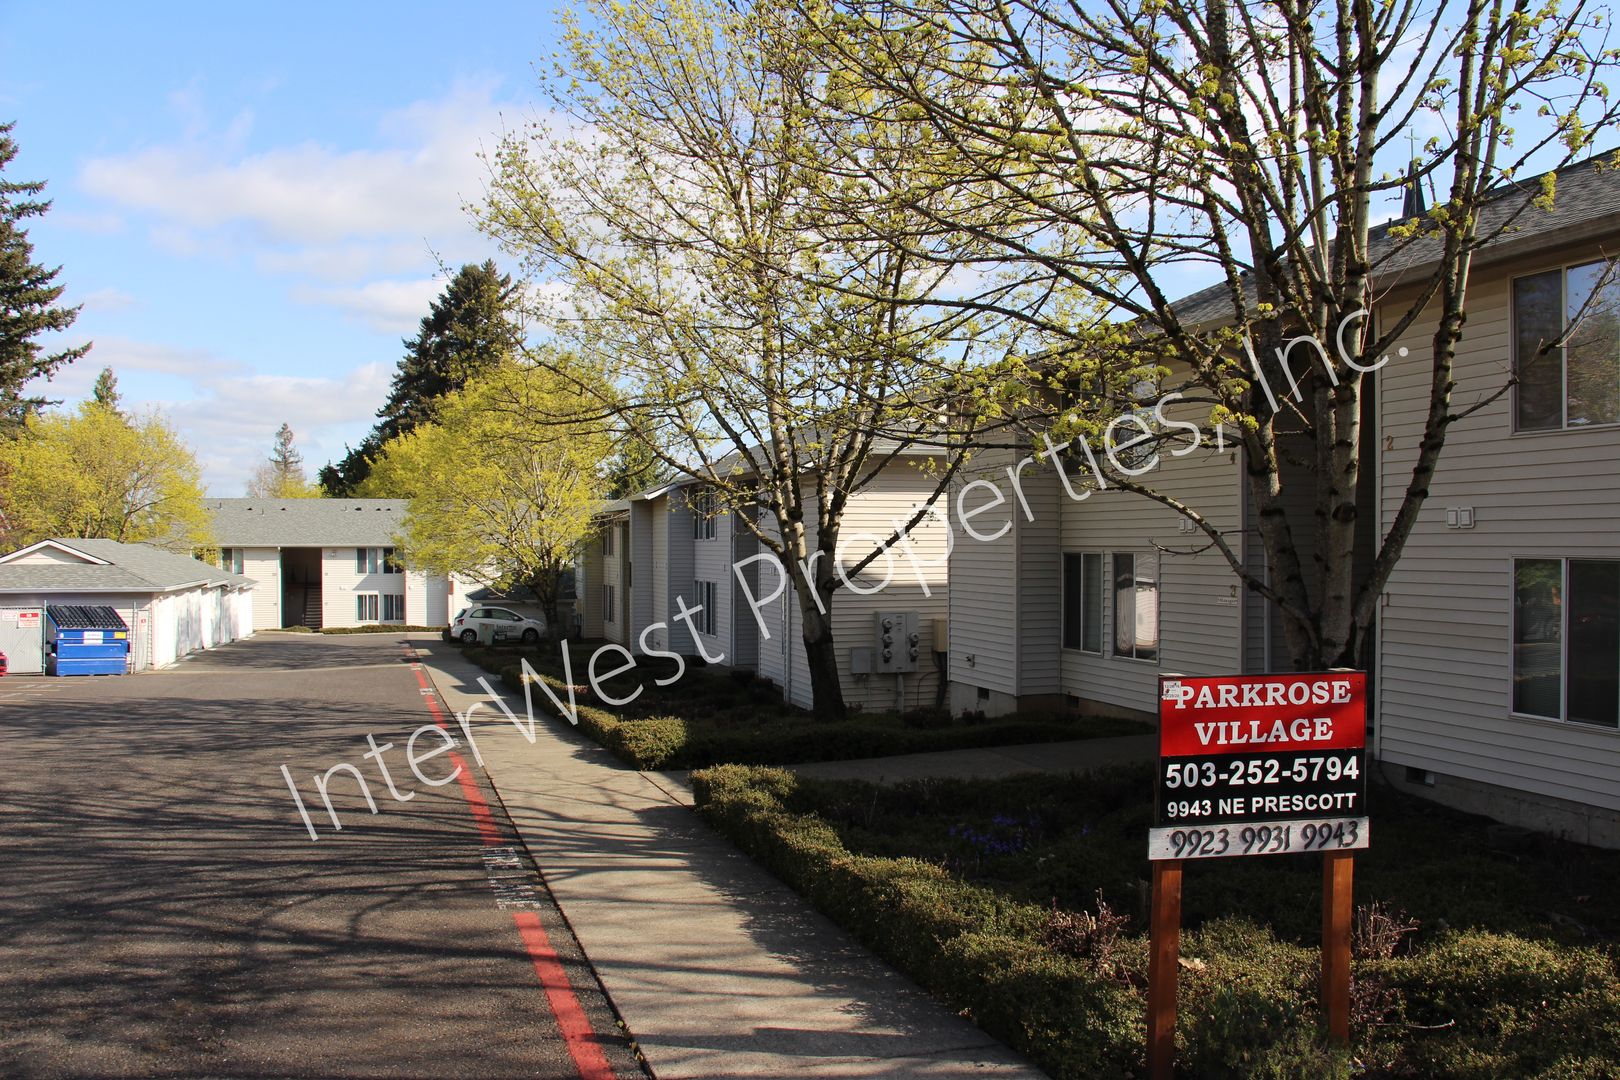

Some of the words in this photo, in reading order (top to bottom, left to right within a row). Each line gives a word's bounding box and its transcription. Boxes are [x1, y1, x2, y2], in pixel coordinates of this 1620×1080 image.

[1174, 680, 1352, 710] PARKROSE
[1194, 717, 1334, 746] VILLAGE
[1165, 755, 1360, 789] 503-252-5794
[1167, 799, 1212, 818] 9943
[1218, 797, 1245, 815] NE
[1251, 792, 1357, 813] PRESCOTT
[1170, 828, 1230, 858] 9923
[1240, 824, 1291, 855] 9931
[1301, 820, 1359, 850] 9943
